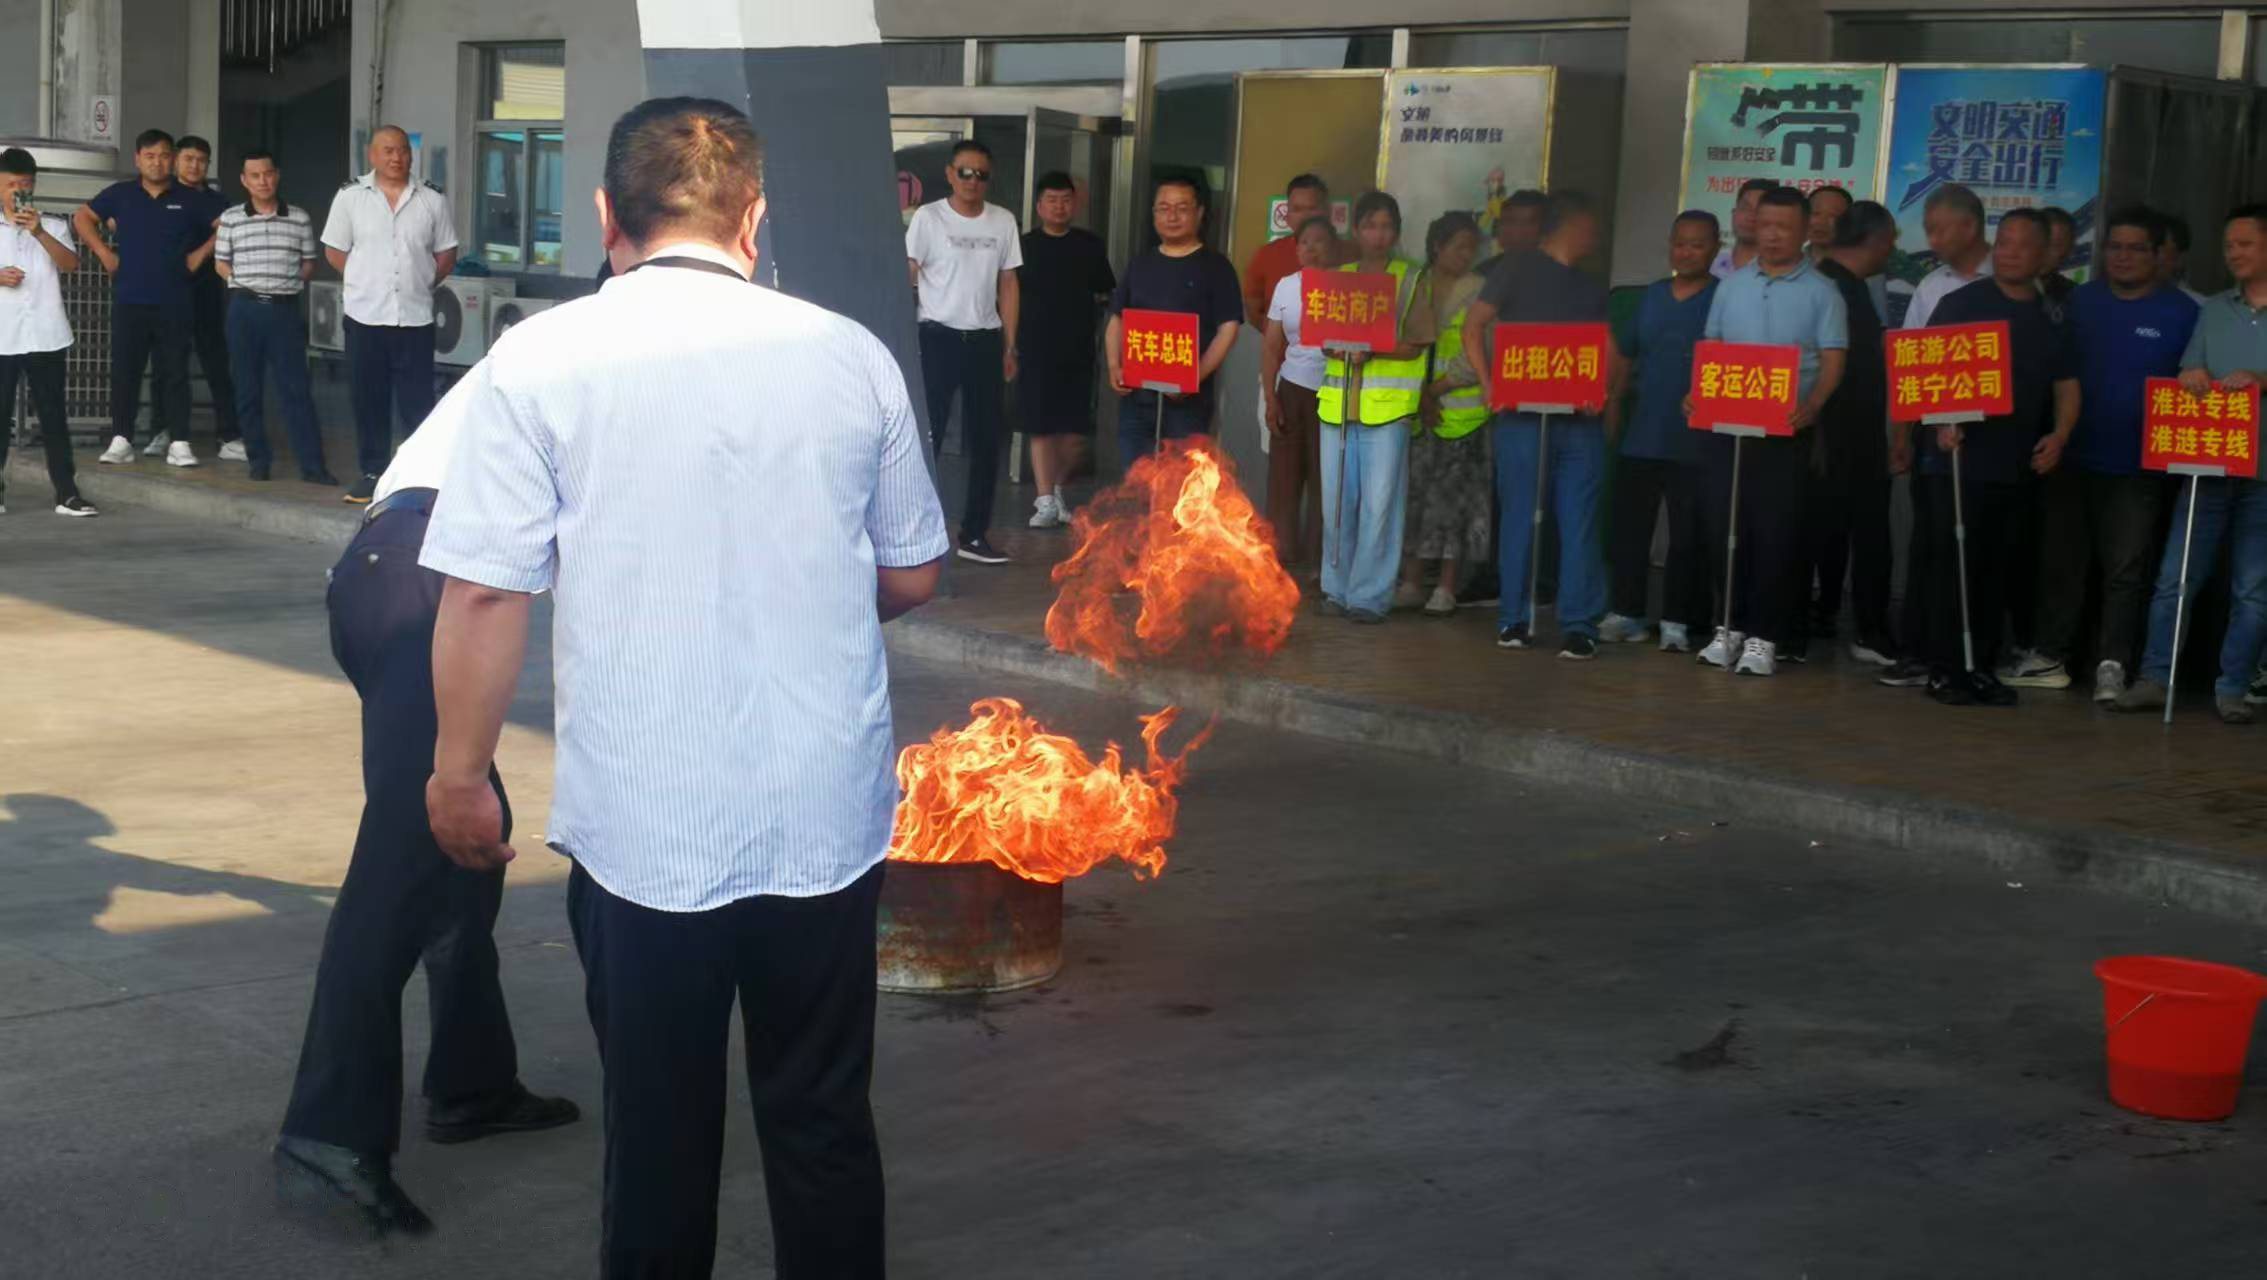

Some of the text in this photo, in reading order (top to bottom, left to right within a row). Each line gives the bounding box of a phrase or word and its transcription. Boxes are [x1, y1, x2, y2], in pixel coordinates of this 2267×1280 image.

[1929, 100, 2069, 142] 文明交通
[1929, 142, 2066, 190] 安全出行
[1306, 289, 1389, 325] 车站商户
[1127, 329, 1193, 367] 汽车总站
[1503, 346, 1599, 381] 出租公司
[1894, 331, 2001, 367] 旅游公司
[1700, 361, 1791, 402] 客运公司
[1896, 369, 2002, 405] 淮宁公司
[2151, 387, 2251, 421] 淮洪专线
[2150, 424, 2250, 459] 淮涟专线
